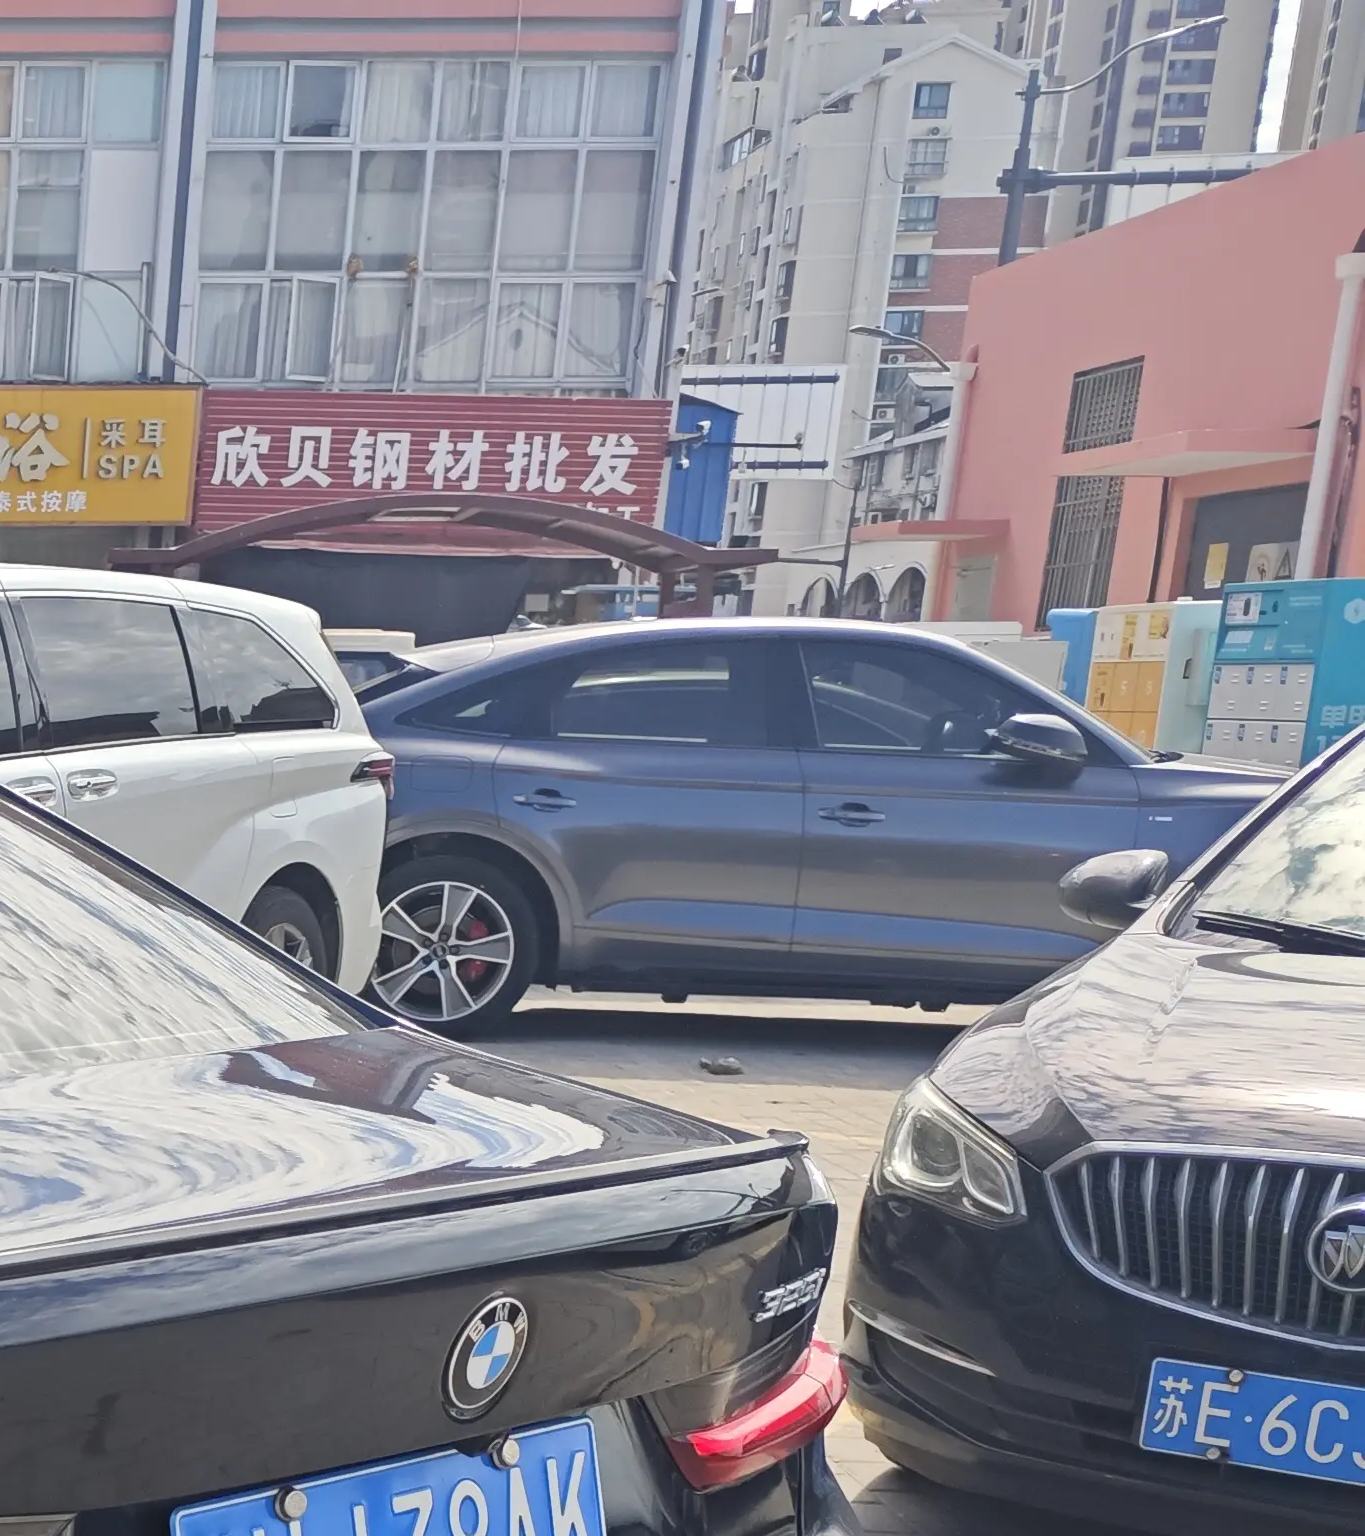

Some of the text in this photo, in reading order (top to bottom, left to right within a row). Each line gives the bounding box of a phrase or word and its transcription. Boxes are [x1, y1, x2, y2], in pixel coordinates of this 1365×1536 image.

[100, 418, 167, 447] 采耳
[98, 455, 164, 479] SPA
[211, 425, 639, 497] 欣贝钢材批发
[468, 1302, 527, 1343] BMW
